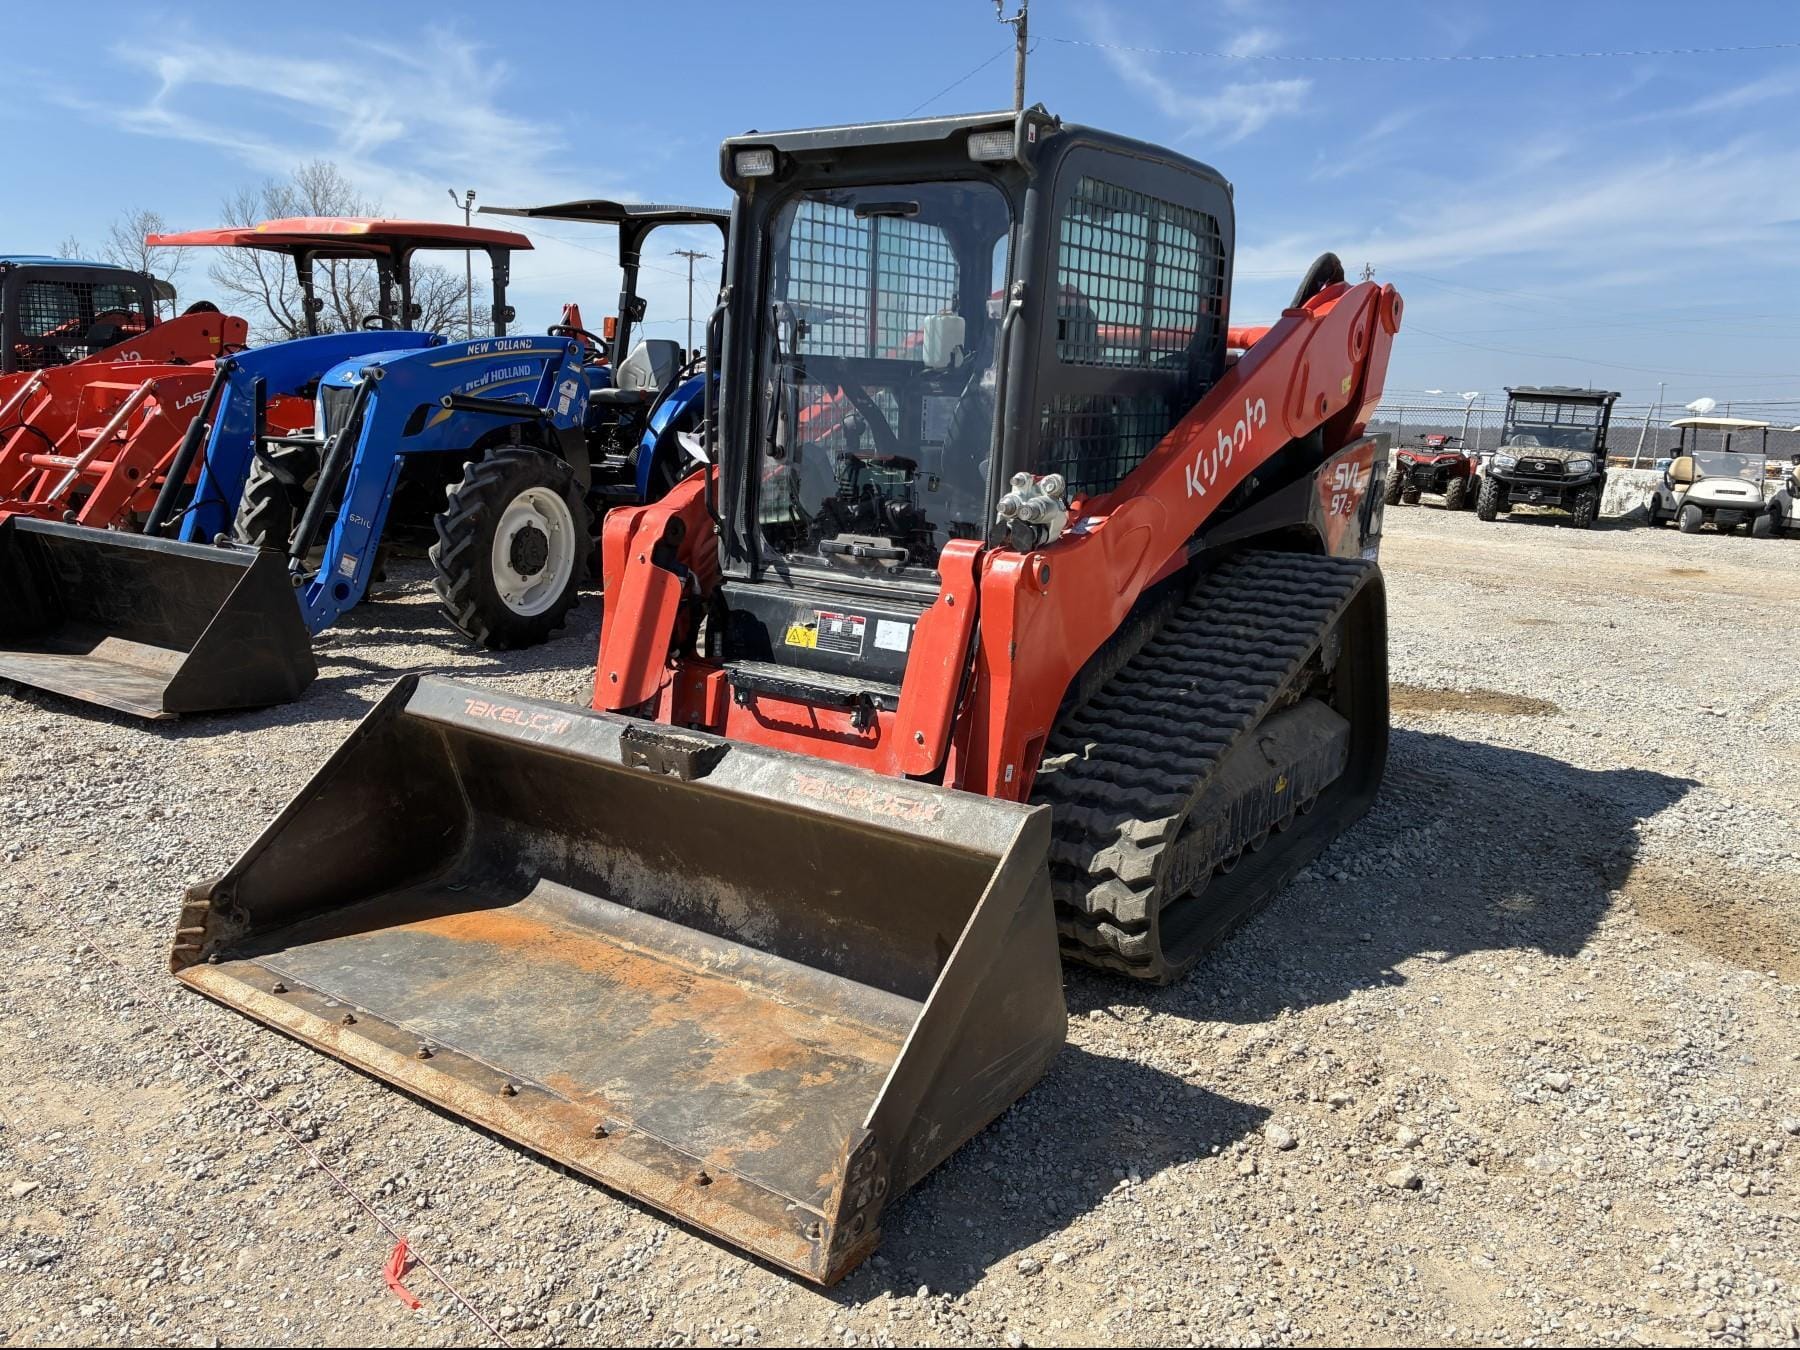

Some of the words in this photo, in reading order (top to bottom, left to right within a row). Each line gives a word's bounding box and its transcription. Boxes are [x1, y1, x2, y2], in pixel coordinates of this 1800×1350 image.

[467, 343, 489, 356] NEW
[495, 338, 532, 351] OLLAND
[491, 364, 531, 383] HOLLAND
[175, 389, 210, 410] LA52
[1185, 397, 1267, 499] Kubota
[1332, 462, 1362, 491] SVL
